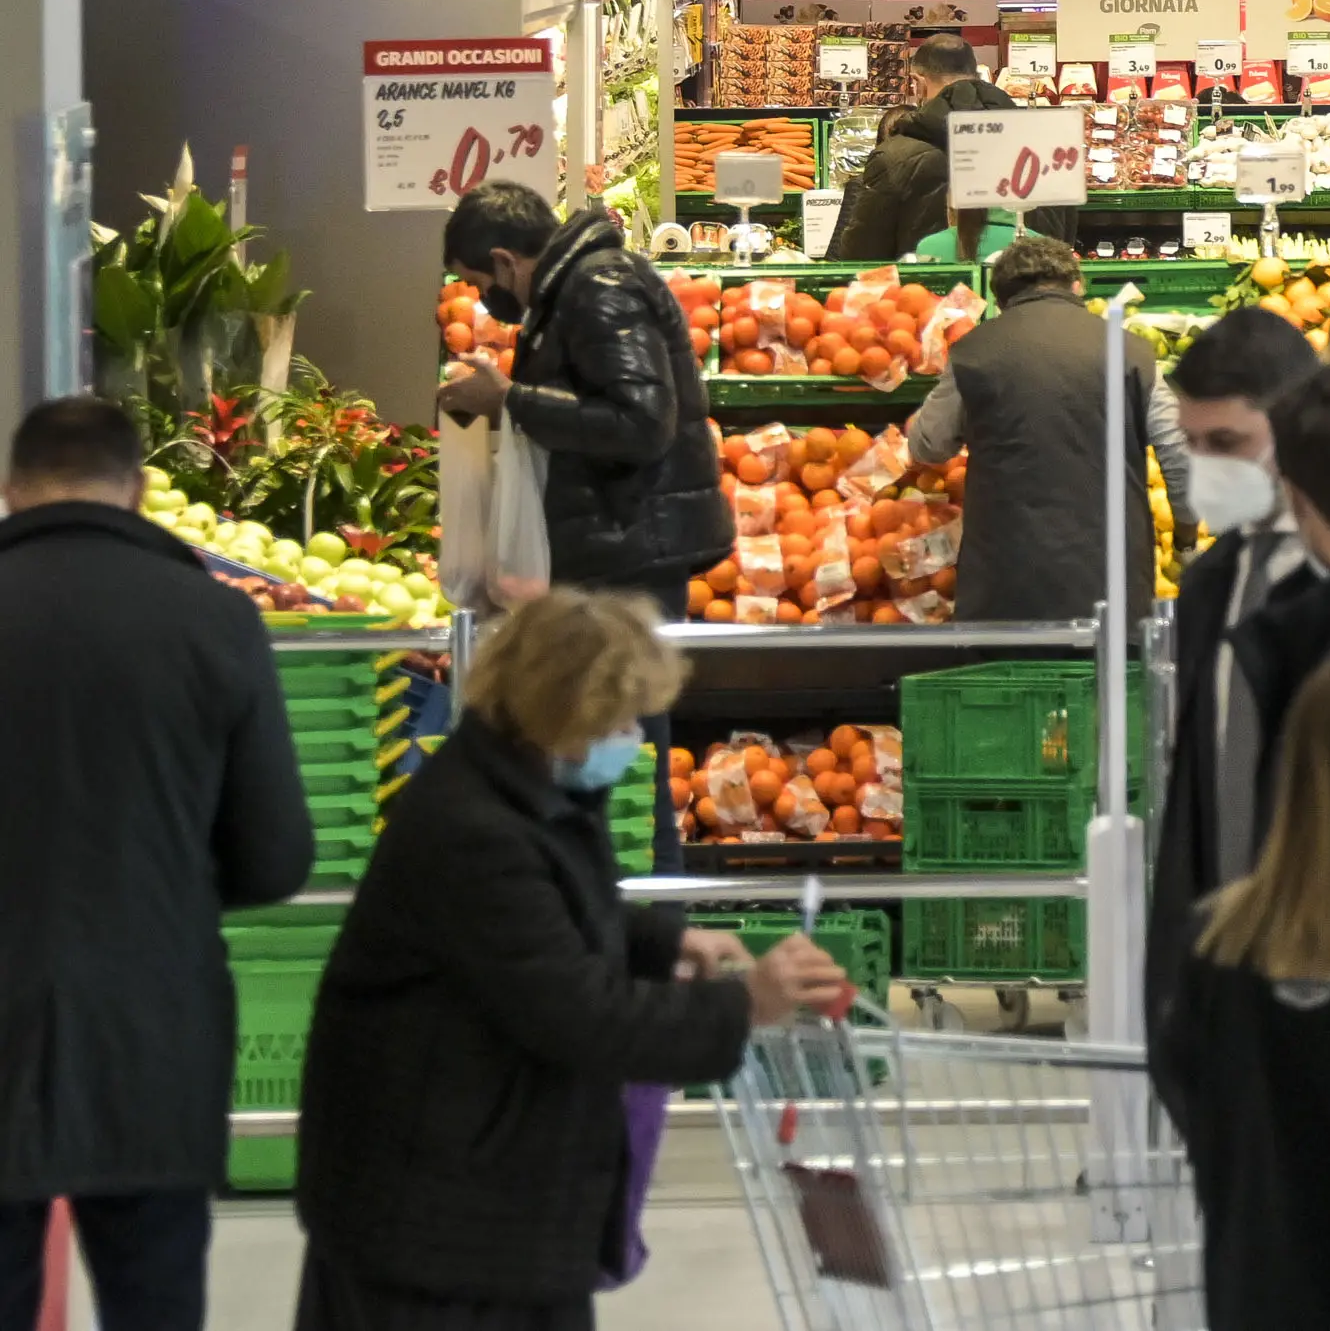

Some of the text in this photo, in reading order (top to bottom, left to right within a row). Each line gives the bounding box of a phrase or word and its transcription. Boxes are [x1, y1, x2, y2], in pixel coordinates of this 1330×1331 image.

[376, 48, 542, 66] GRANDI OCCASIONI
[840, 63, 861, 75] 2,49
[1029, 60, 1049, 73] 1,79
[1128, 60, 1150, 73] 3,49
[1214, 58, 1237, 72] 0,99
[1307, 58, 1328, 71] 1,80
[375, 80, 516, 101] ARANCE NAVEL KG
[449, 123, 544, 198] 0,79
[1011, 145, 1079, 200] 0,99
[1266, 177, 1295, 195] 1,99
[1203, 230, 1225, 244] 2,99
